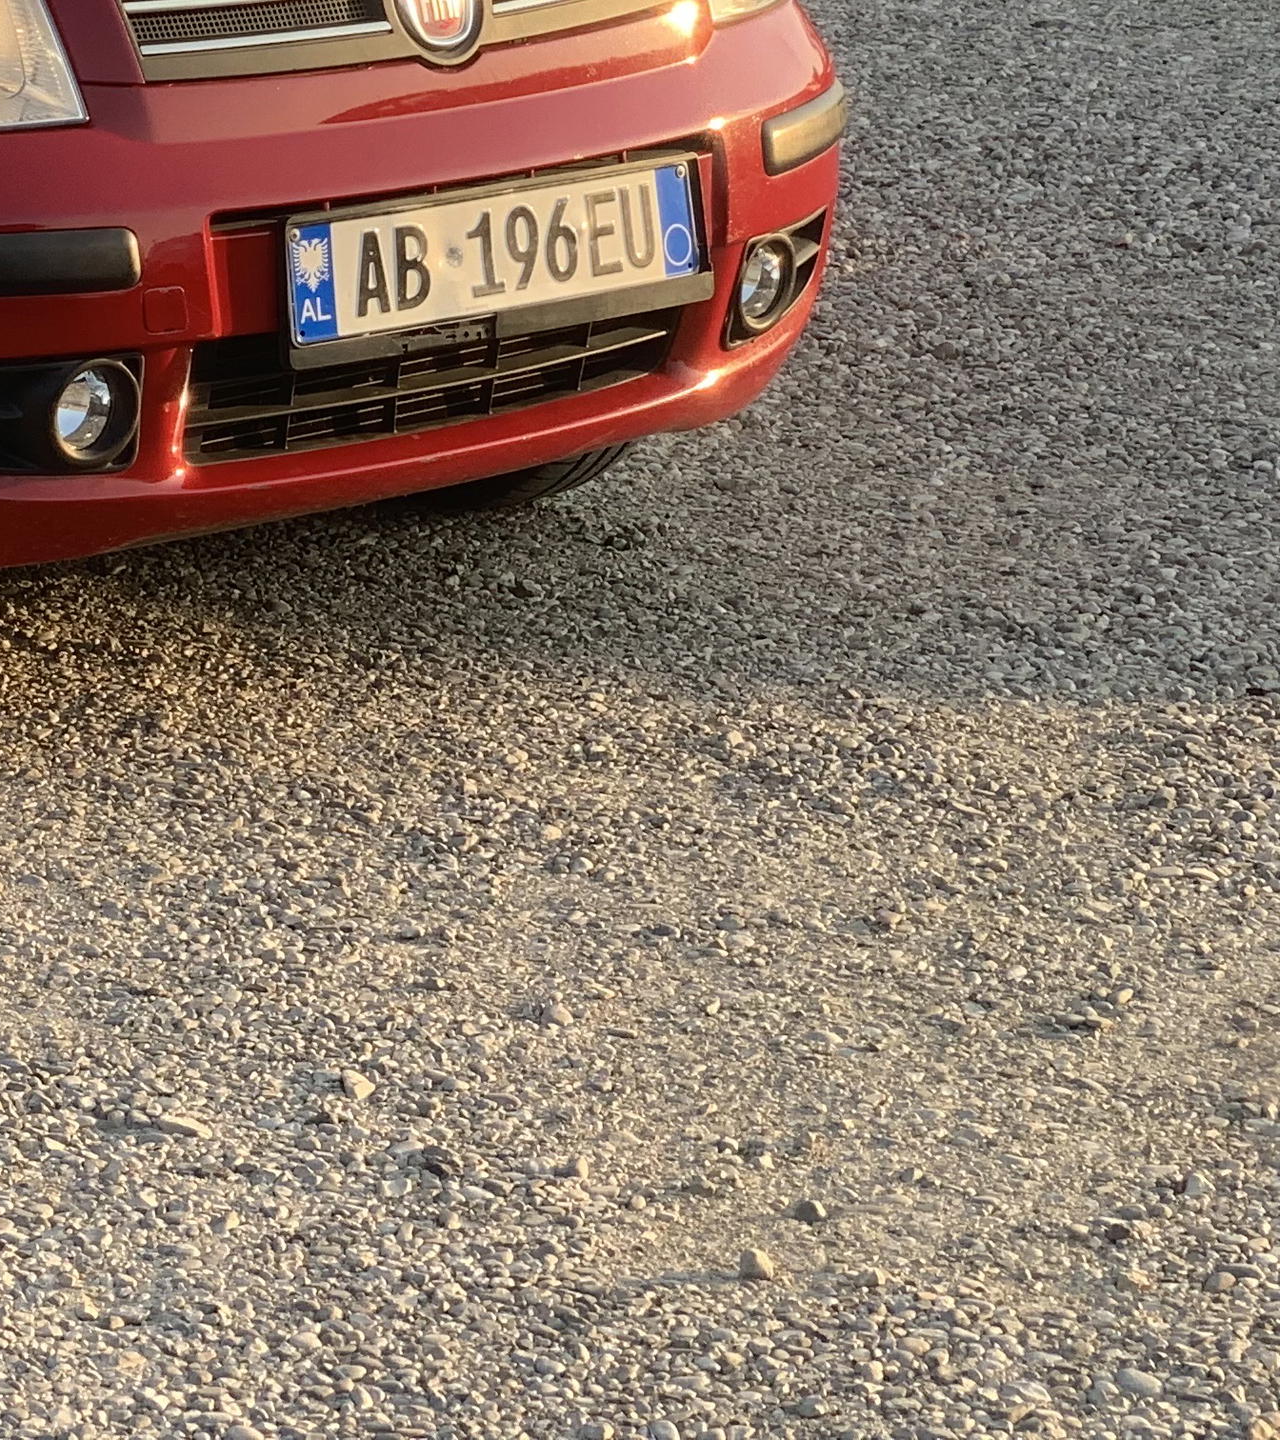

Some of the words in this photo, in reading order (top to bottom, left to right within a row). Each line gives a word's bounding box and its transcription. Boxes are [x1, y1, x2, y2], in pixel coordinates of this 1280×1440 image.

[357, 225, 432, 318] AB
[465, 183, 655, 298] 196EU
[300, 296, 332, 324] AL
